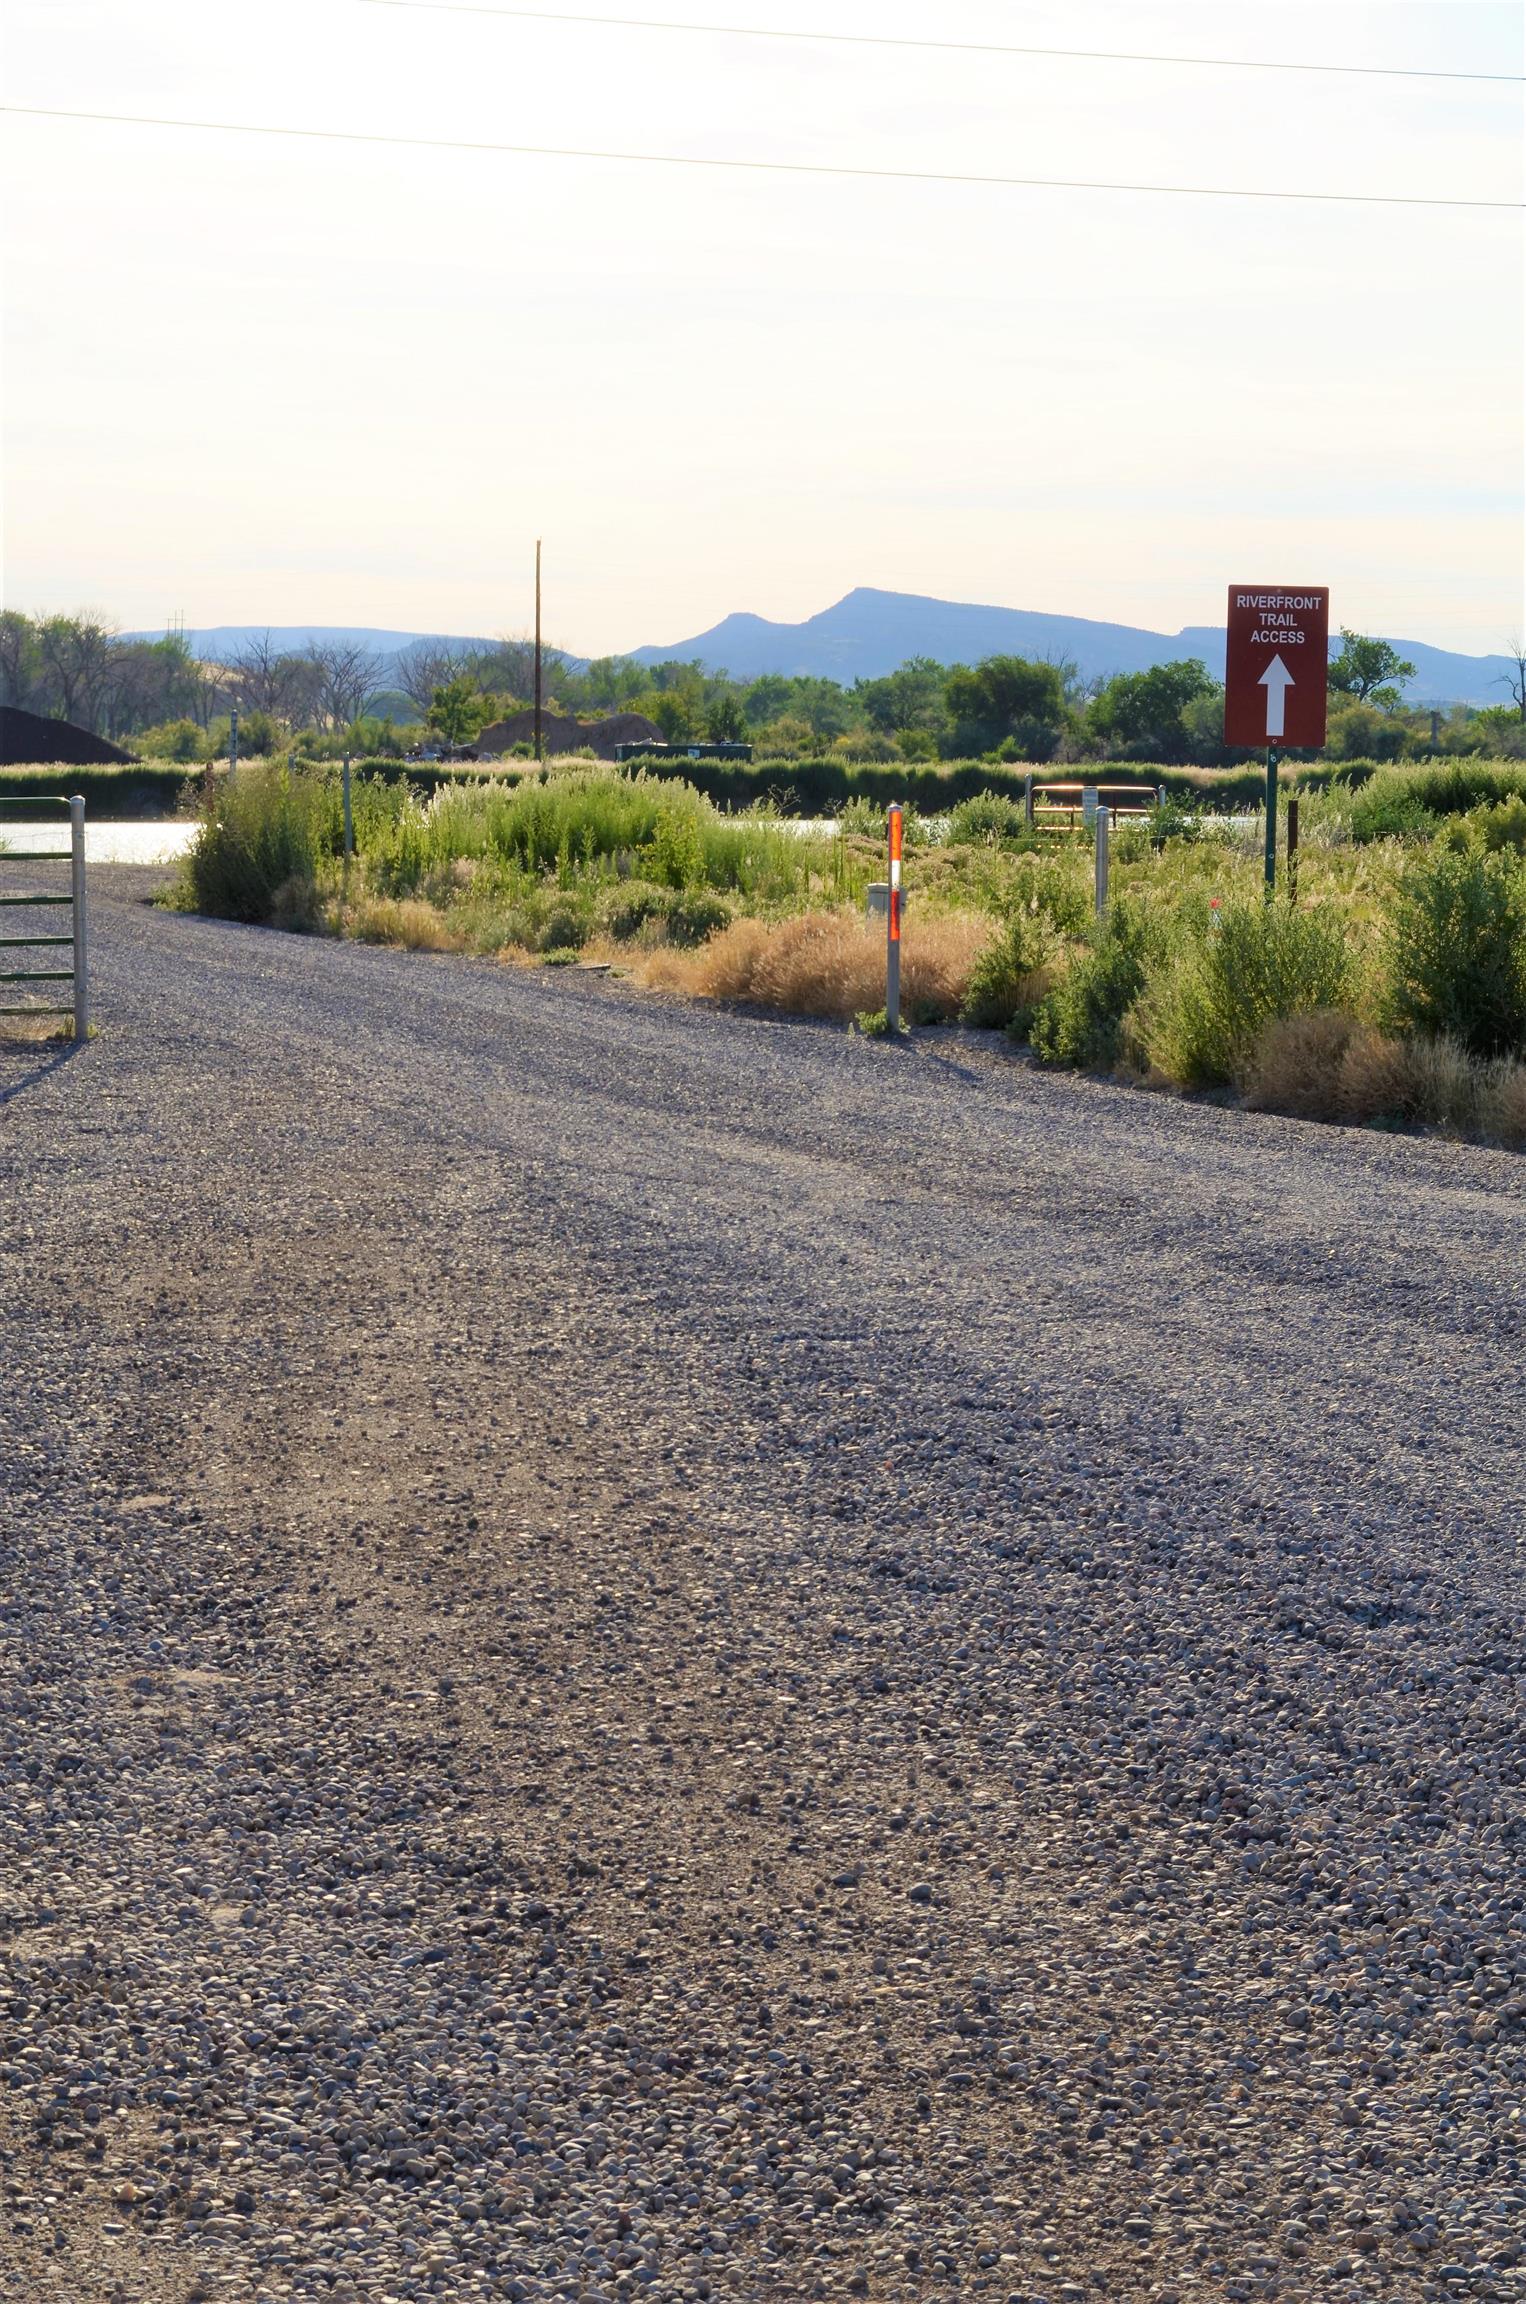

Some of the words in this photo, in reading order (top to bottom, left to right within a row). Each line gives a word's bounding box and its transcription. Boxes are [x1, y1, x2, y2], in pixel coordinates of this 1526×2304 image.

[1237, 595, 1321, 609] RIVERFRONT
[1259, 613, 1298, 626] TRAIL
[1250, 630, 1305, 644] ACCESS
